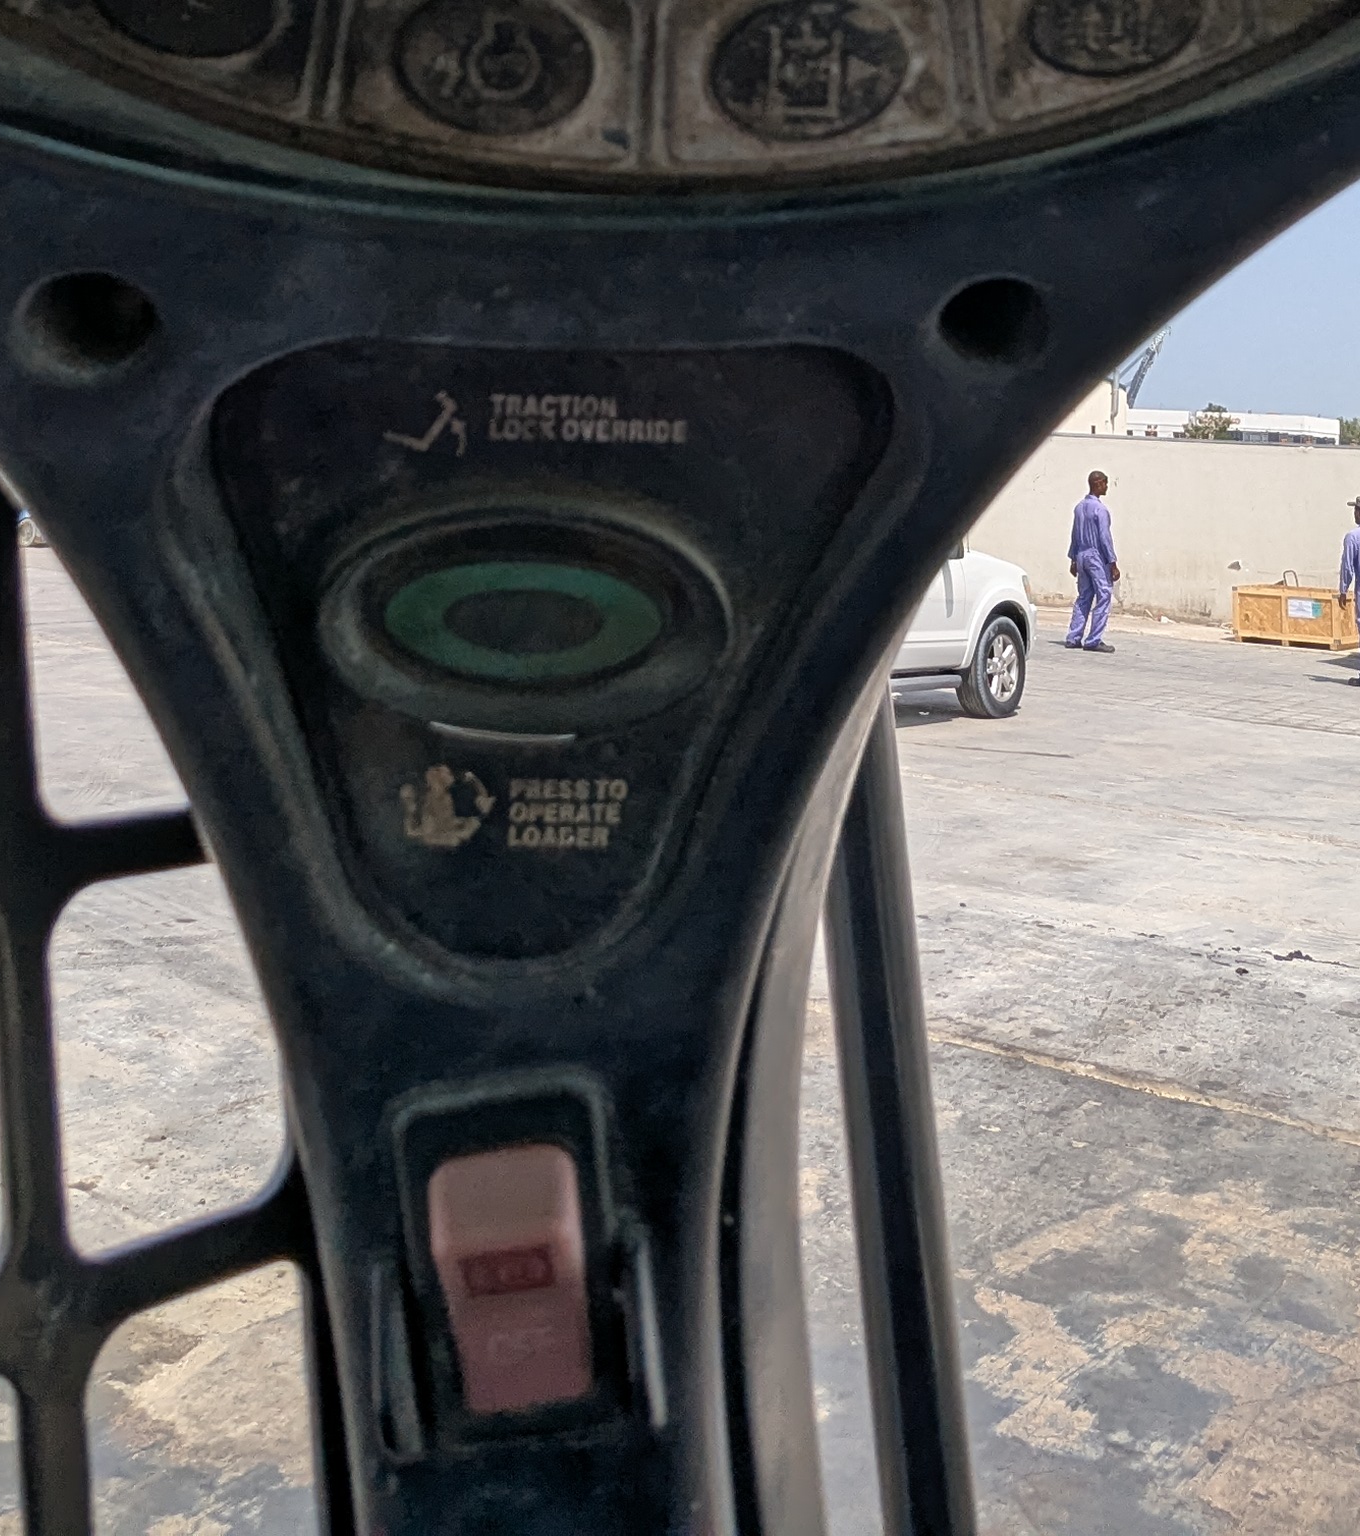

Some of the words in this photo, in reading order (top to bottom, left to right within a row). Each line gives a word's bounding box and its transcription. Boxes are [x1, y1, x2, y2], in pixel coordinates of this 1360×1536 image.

[490, 393, 618, 417] TRACTION
[561, 419, 687, 443] OVERRIDE
[509, 778, 591, 799] PRESS
[594, 778, 629, 800] TO
[509, 802, 621, 823] OPERATE
[507, 825, 610, 847] LOADER
